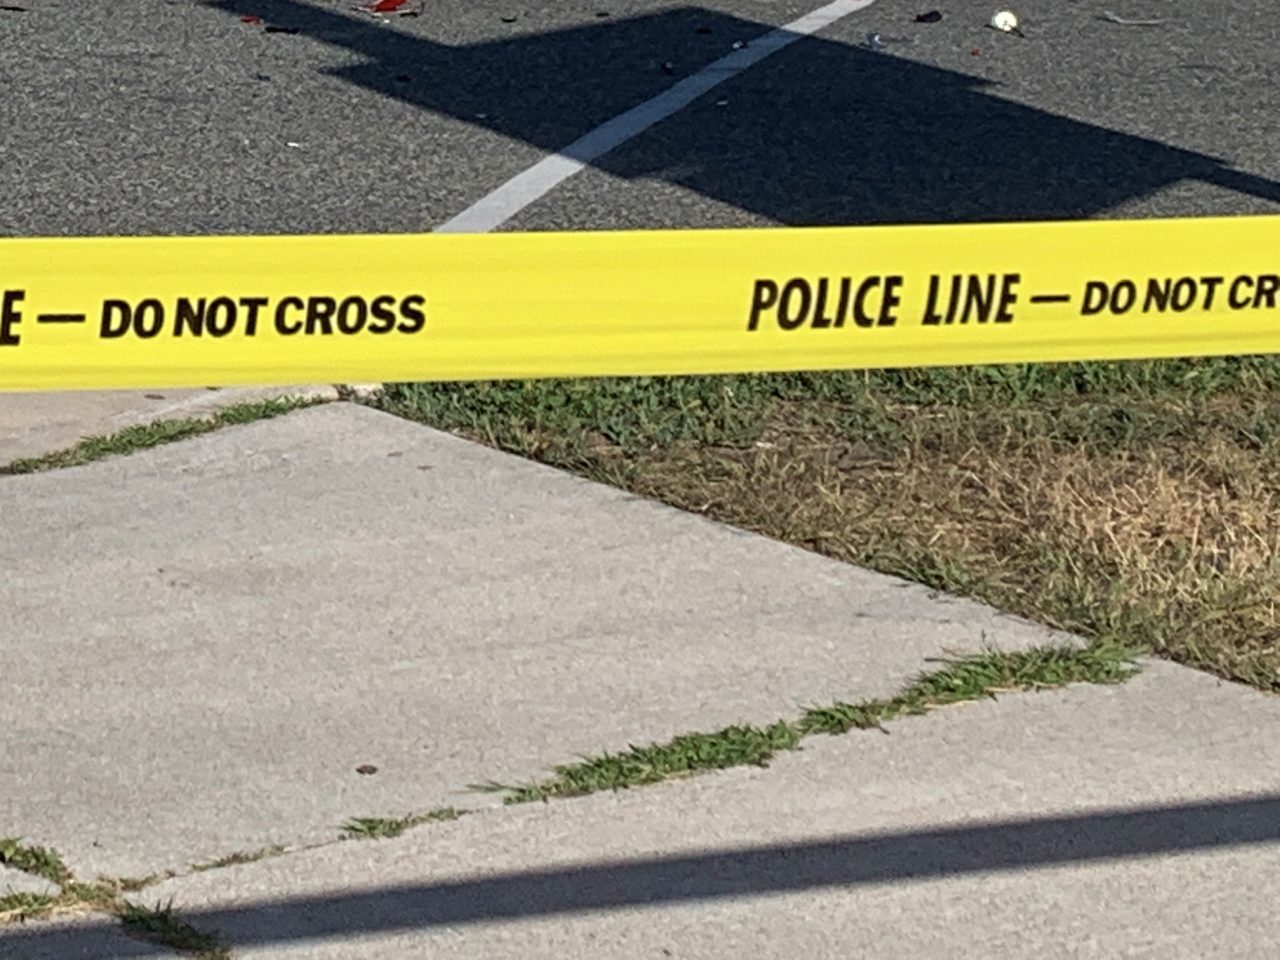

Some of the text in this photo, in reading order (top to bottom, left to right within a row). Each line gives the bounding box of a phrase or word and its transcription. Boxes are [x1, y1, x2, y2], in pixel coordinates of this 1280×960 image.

[100, 299, 165, 339] DO
[173, 296, 269, 338] NOT
[274, 295, 426, 335] CROSS
[748, 276, 903, 331] POLICE
[922, 273, 1020, 326] LINE
[1081, 280, 1136, 315] DO
[1142, 277, 1224, 313] NOT
